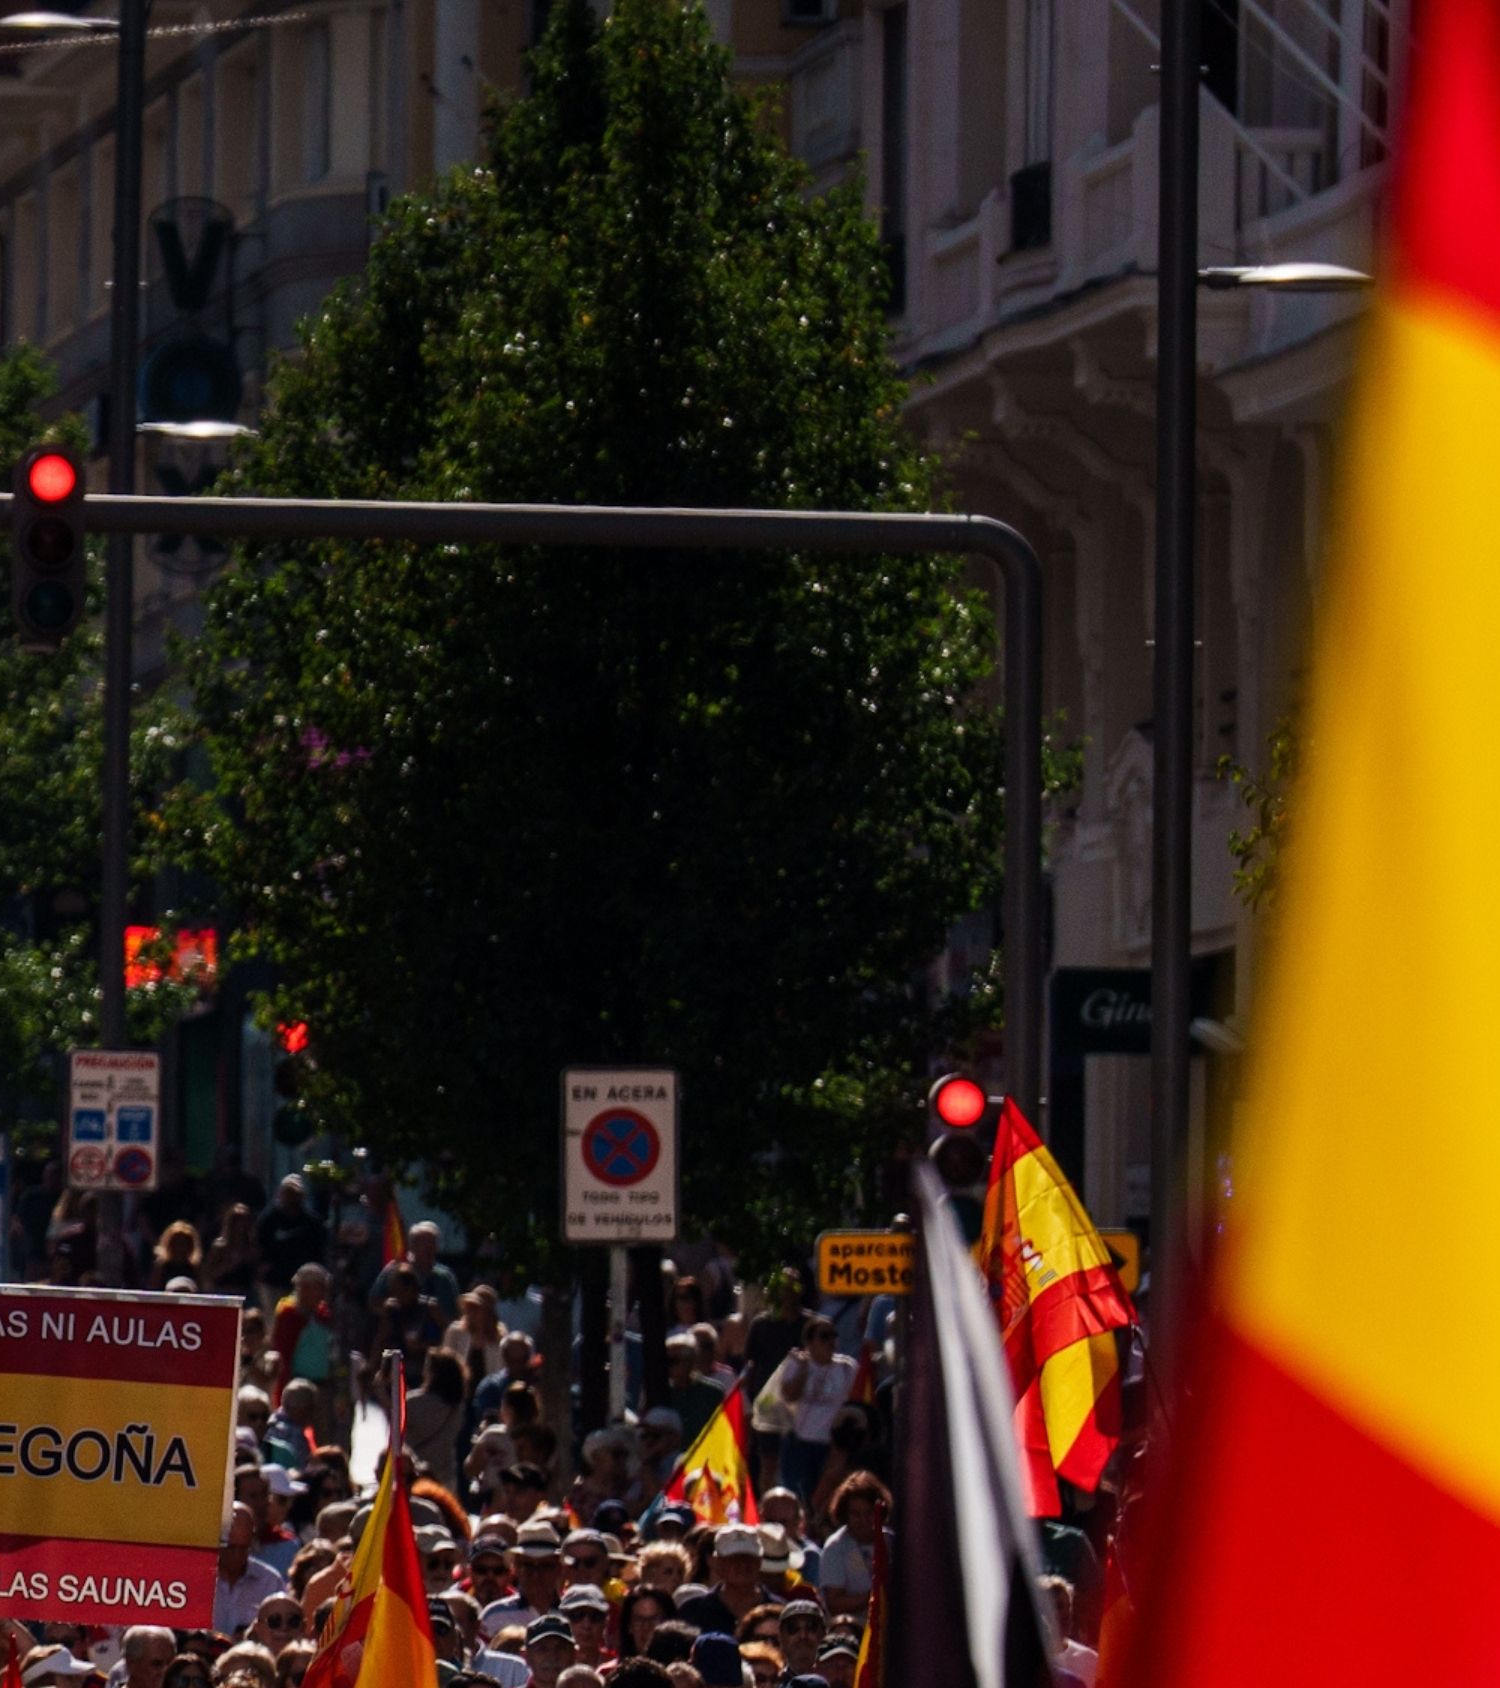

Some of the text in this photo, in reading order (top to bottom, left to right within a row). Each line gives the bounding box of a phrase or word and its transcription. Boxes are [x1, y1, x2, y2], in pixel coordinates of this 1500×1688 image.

[572, 1085, 667, 1100] EN ACERA
[41, 1312, 76, 1341] NI
[86, 1315, 203, 1352] AULAS
[57, 1574, 188, 1610] SAUNAS
